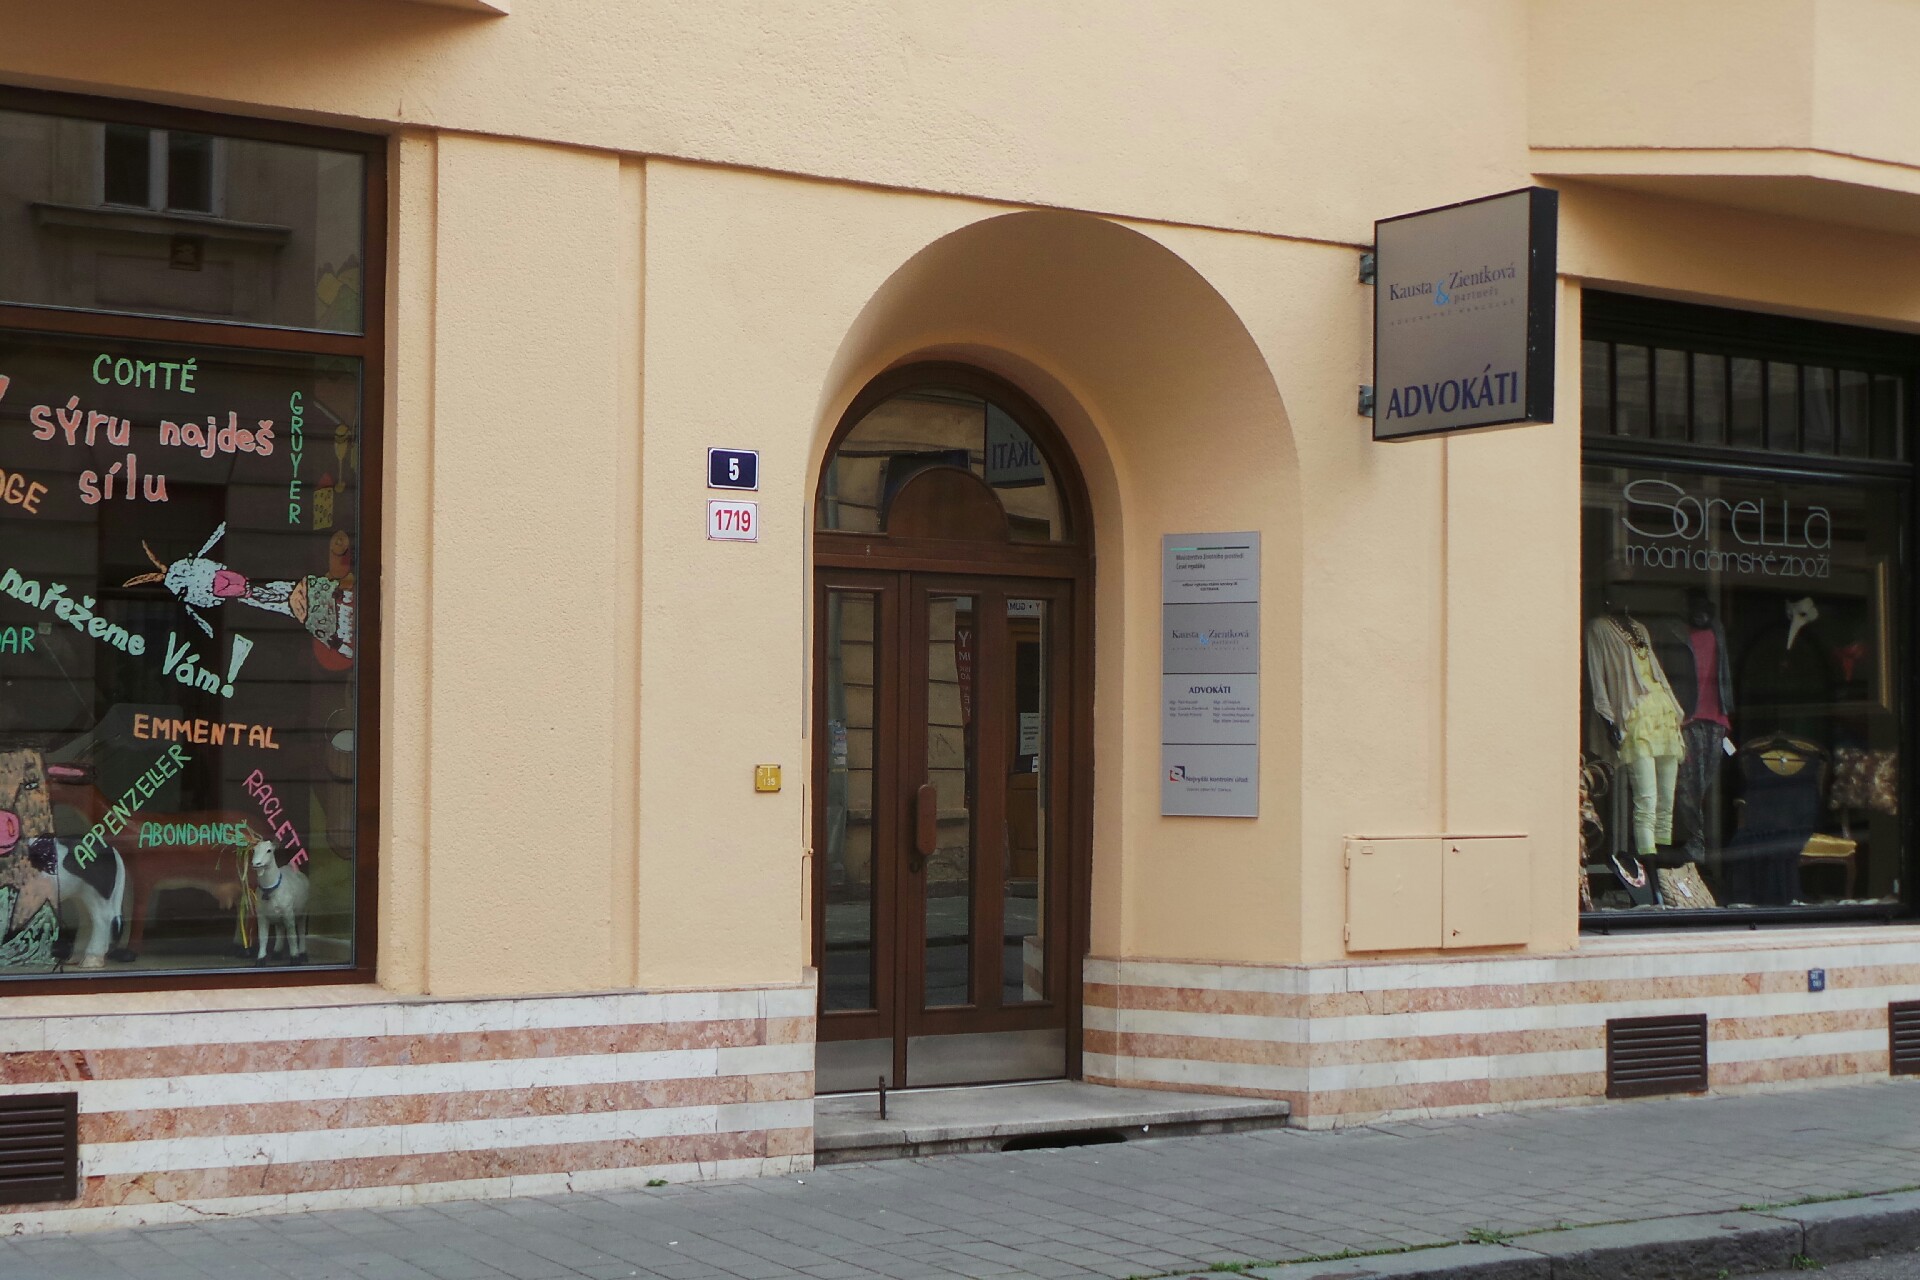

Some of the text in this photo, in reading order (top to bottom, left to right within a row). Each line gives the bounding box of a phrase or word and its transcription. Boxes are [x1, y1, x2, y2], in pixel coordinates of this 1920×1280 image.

[1389, 262, 1516, 305] Kausta & Zientková
[92, 354, 198, 393] COMTÉ
[1386, 364, 1518, 420] ADVOKÁTI
[30, 396, 274, 458] sýru najdeš
[288, 391, 304, 524] GRUYER
[729, 458, 740, 481] 5
[78, 453, 168, 504] sílu
[715, 509, 751, 532] 1719
[1625, 543, 1830, 578] módní dámské zboží
[0, 568, 146, 656] nařežeme
[0, 626, 35, 654] AR
[1172, 630, 1199, 639] Kausta
[162, 632, 253, 698] Vám!
[1188, 685, 1231, 695] ADVOKÁTI
[133, 714, 279, 750] EMMENTAL
[73, 744, 192, 870] APPENZELLER
